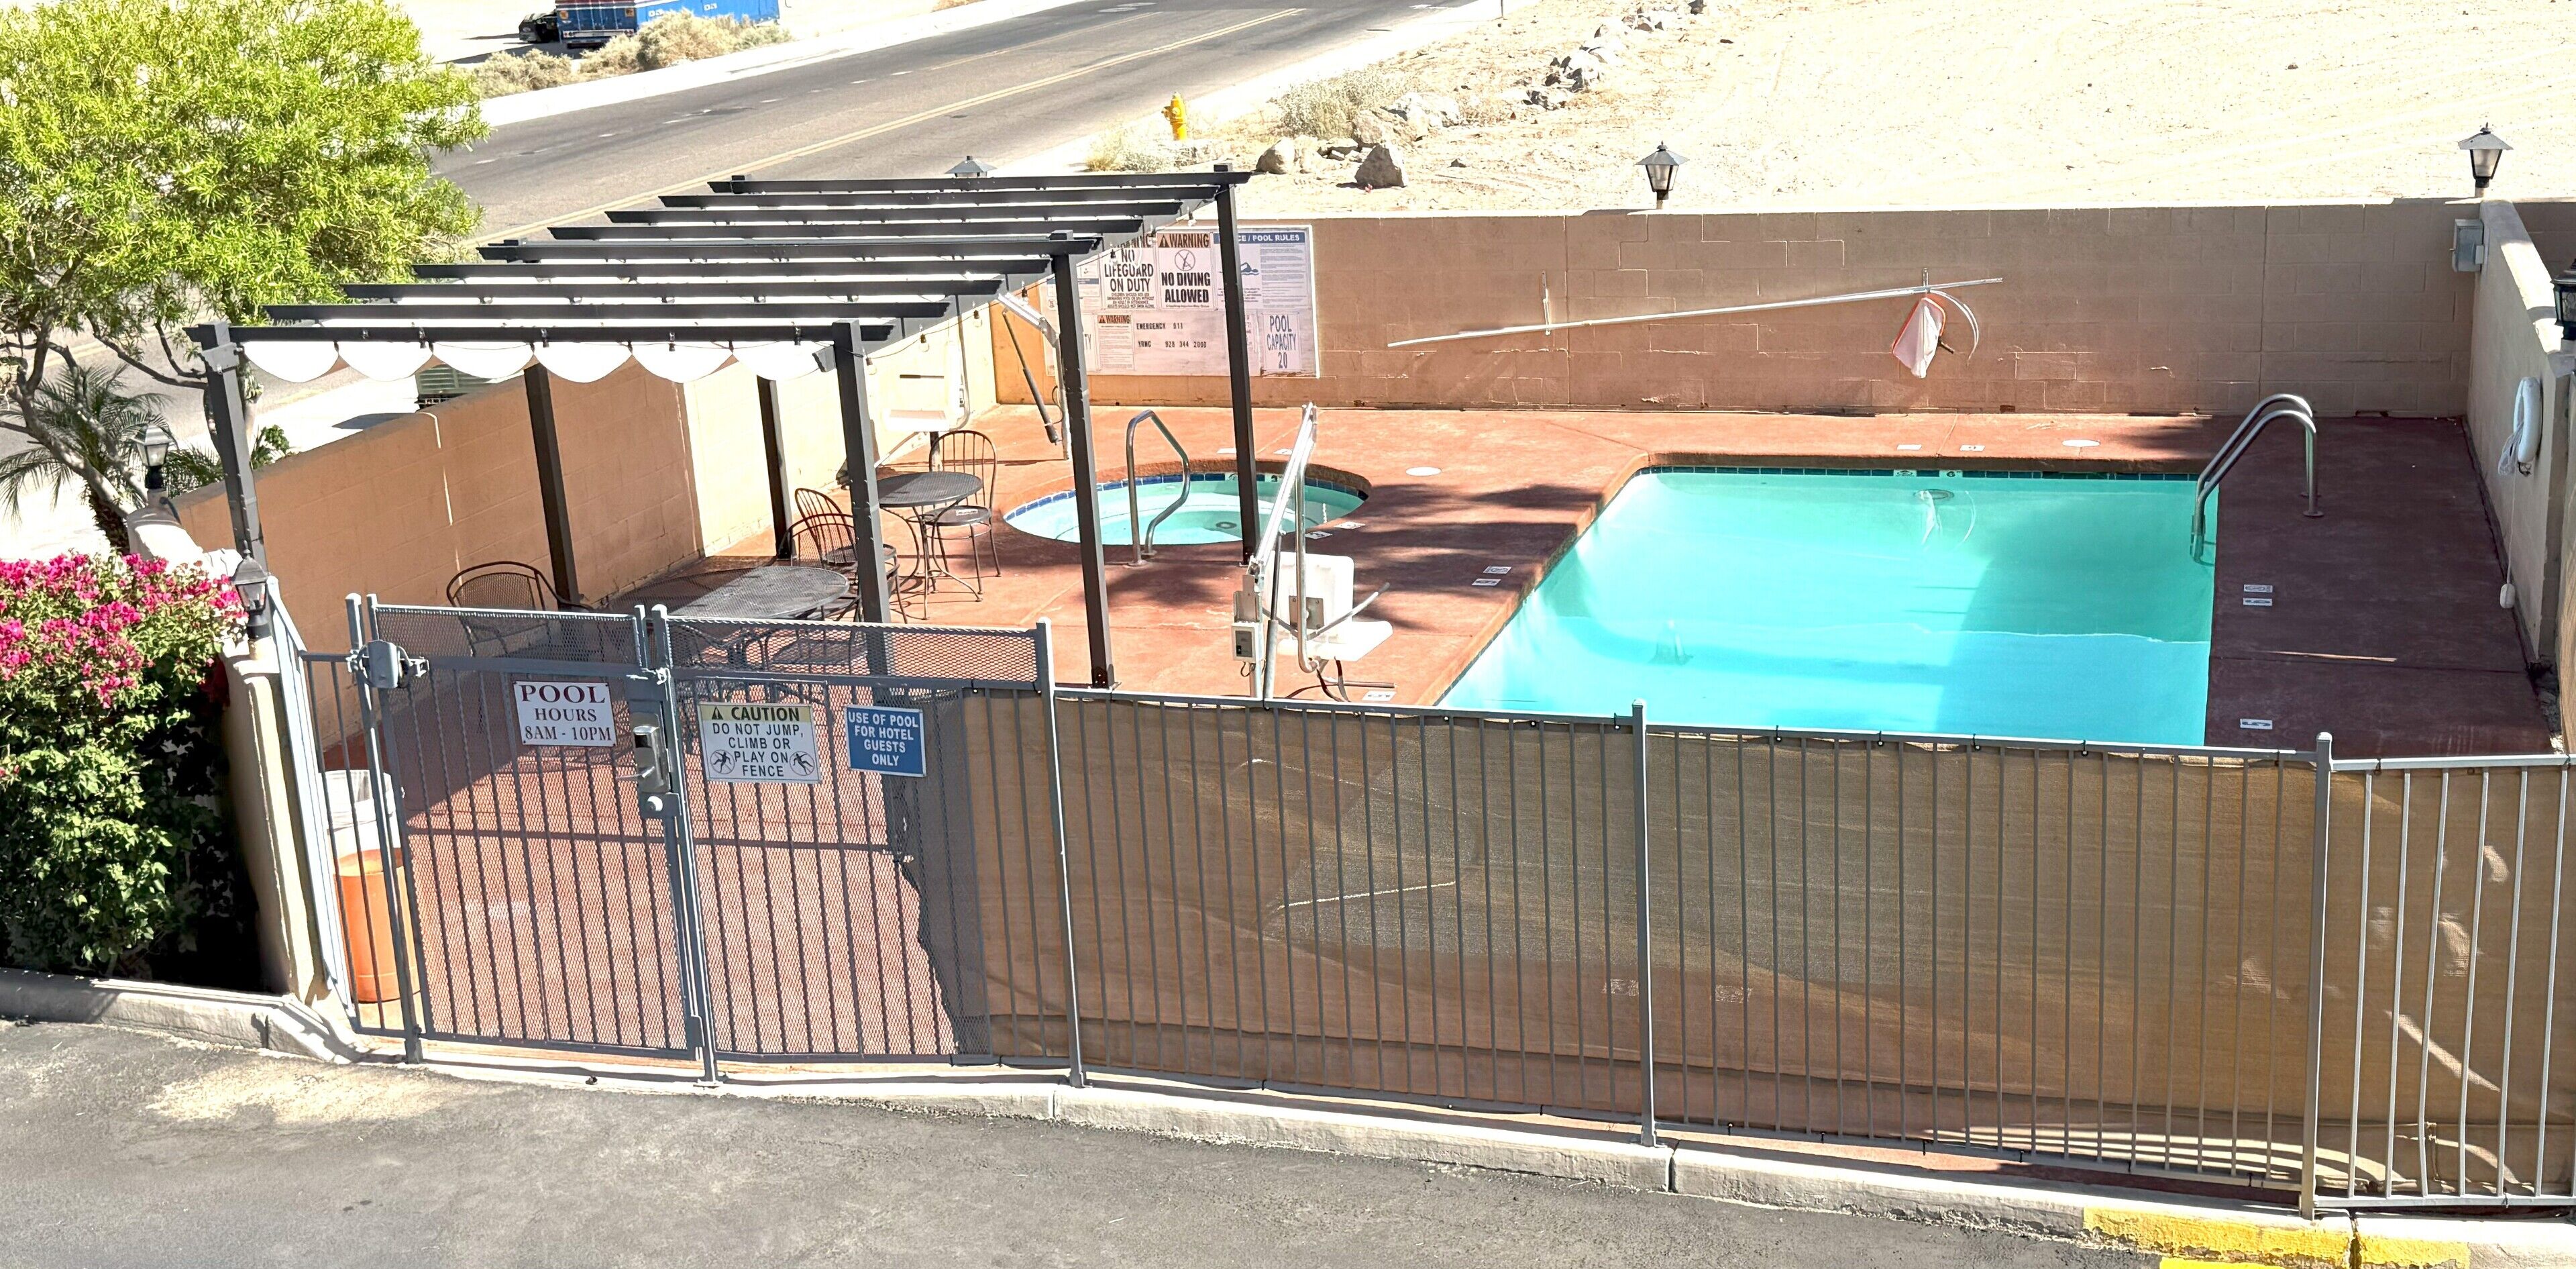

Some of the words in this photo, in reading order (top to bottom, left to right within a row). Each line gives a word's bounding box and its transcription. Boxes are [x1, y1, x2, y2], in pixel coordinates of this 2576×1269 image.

[1169, 233, 1210, 248] WARNING
[1121, 249, 1135, 262] NO
[1104, 264, 1154, 277] LIFEGUARD
[1110, 278, 1124, 292] ON
[1127, 278, 1150, 292] DUTY
[1161, 272, 1175, 286] NO
[1177, 272, 1211, 287] DIVING
[1165, 289, 1210, 303] ALLOWED
[1106, 315, 1131, 323] WARNING
[1269, 315, 1292, 332] POOL
[1267, 334, 1296, 351] CAPACITY
[1278, 352, 1288, 368] 20
[519, 684, 606, 703] POOL
[535, 708, 597, 721] HOURS
[731, 707, 800, 721] CAUTION
[848, 712, 869, 724] USE
[872, 713, 886, 725] OF
[890, 715, 918, 727] POOL
[525, 725, 558, 740] 8AM
[572, 727, 612, 741] 10PM
[712, 723, 730, 734] DO
[735, 723, 760, 735] NOT
[766, 724, 804, 738] JUMP,
[855, 725, 875, 738] FOR
[879, 727, 914, 740] HOTEL
[729, 737, 767, 749] CLIMB
[773, 738, 791, 750] OR
[864, 739, 906, 753] GUESTS
[734, 751, 765, 762] PLAY
[771, 751, 788, 763] ON
[872, 753, 900, 766] ONLY
[742, 765, 784, 777] FENCE
